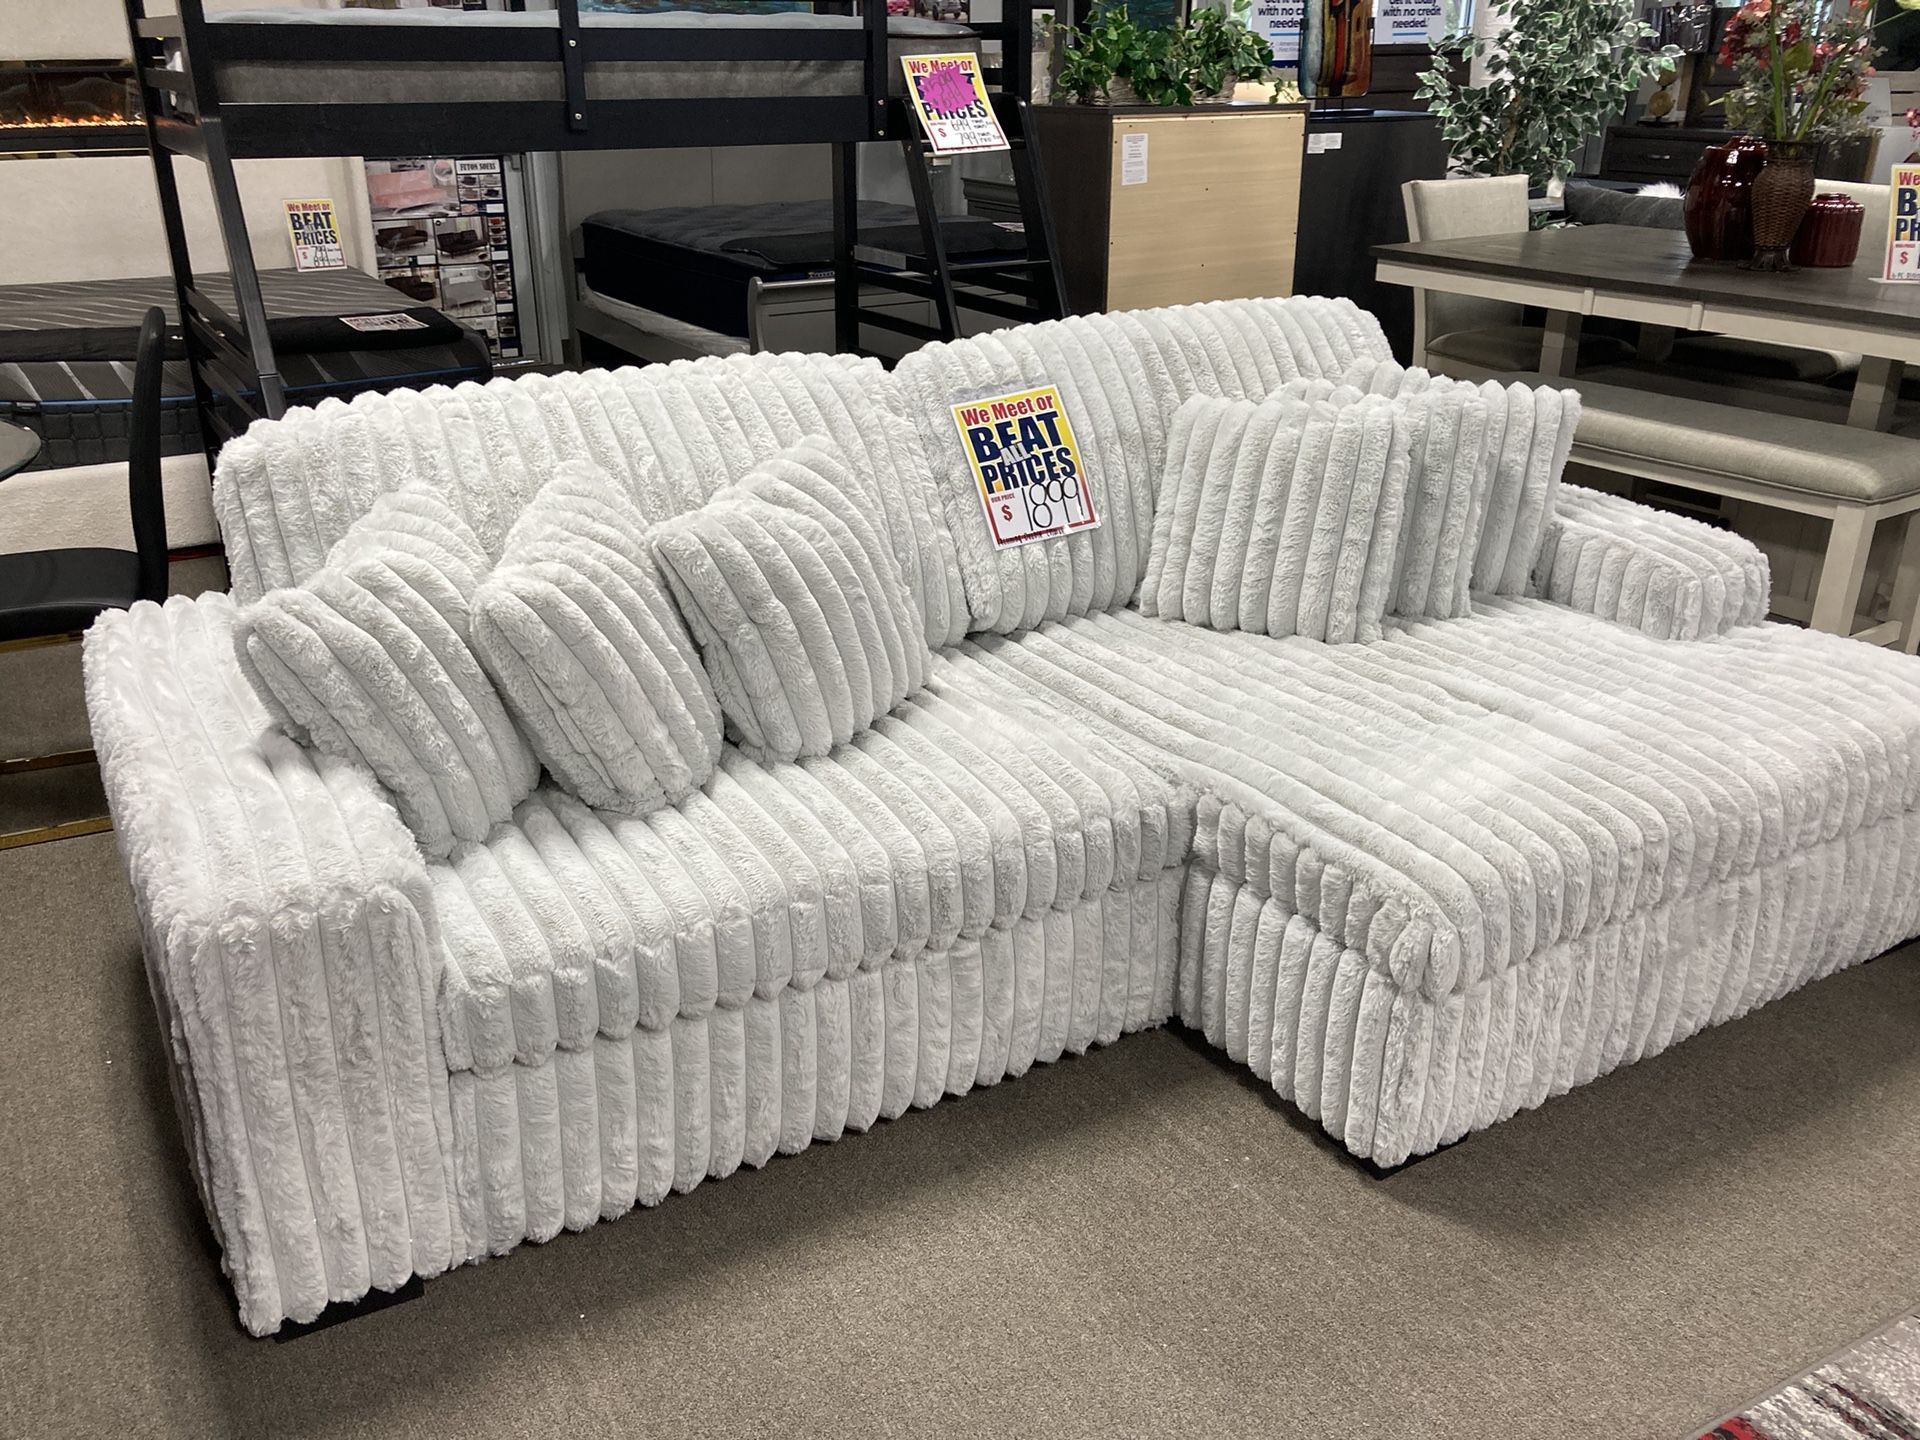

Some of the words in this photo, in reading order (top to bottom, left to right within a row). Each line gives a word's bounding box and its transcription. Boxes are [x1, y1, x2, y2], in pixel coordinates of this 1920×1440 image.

[1258, 5, 1279, 16] with
[1281, 8, 1294, 16] no
[1383, 6, 1401, 16] with
[1403, 8, 1416, 16] no
[1417, 5, 1442, 16] credit
[1269, 18, 1301, 28] neede
[908, 60, 929, 74] We
[960, 60, 973, 71] or
[938, 127, 947, 138] $
[1898, 171, 1920, 186] We
[287, 203, 300, 212] We
[301, 203, 321, 212] Meet
[290, 212, 332, 230] BEAT
[294, 230, 338, 246] PRICES
[1900, 251, 1908, 265] $
[960, 408, 990, 427] We
[991, 398, 1036, 421] Meet
[1037, 395, 1054, 411] or
[967, 411, 1063, 463] BEAT
[1000, 442, 1032, 466] ALL
[980, 447, 1077, 494] PRICES
[1001, 493, 1016, 502] PRICE
[1001, 503, 1013, 522] $
[1021, 476, 1085, 532] 1899
